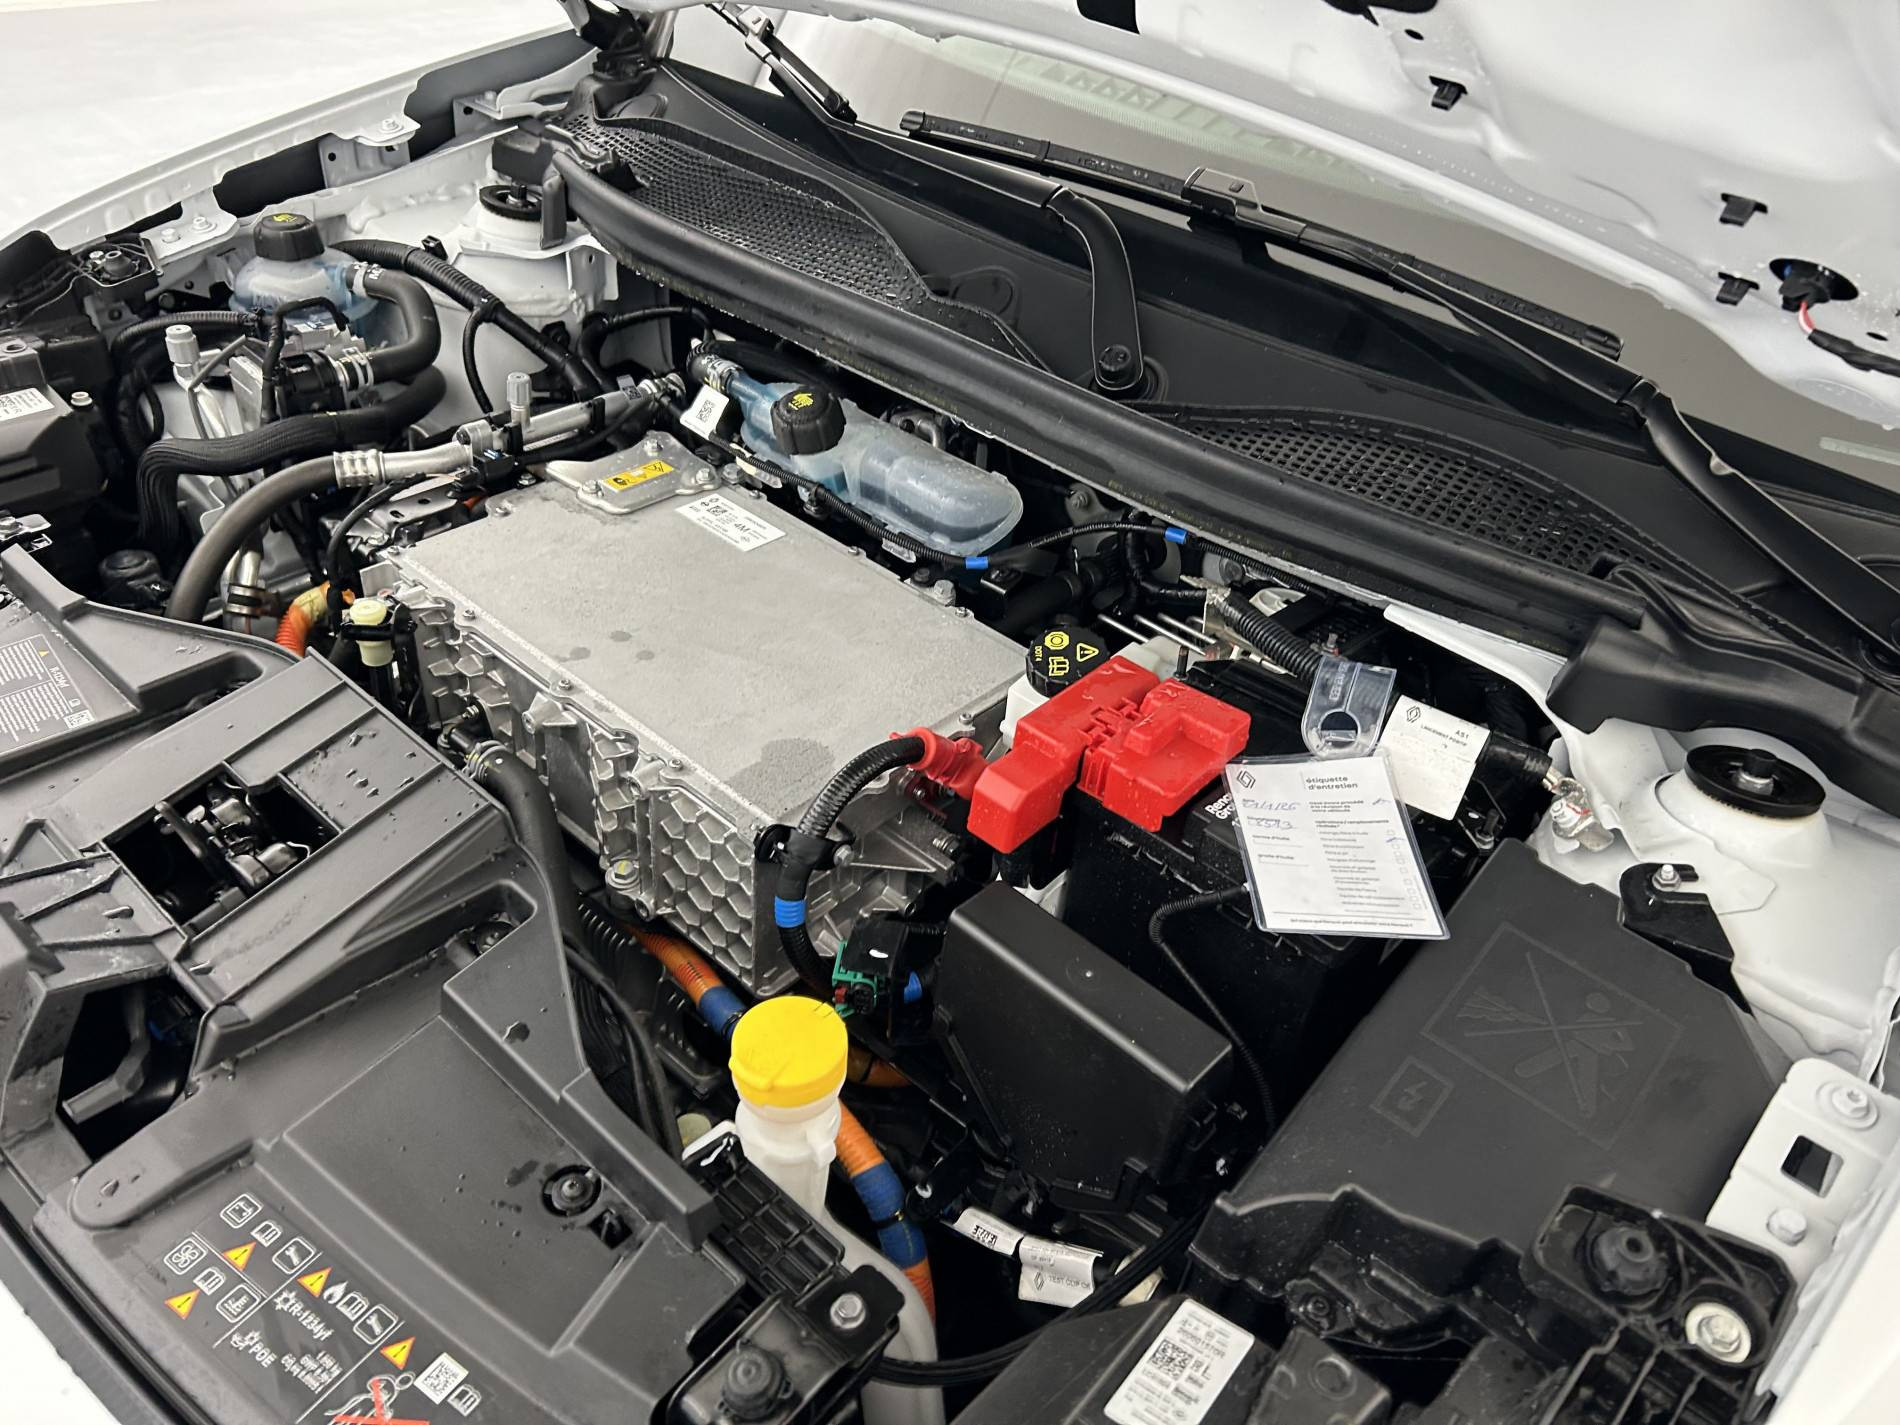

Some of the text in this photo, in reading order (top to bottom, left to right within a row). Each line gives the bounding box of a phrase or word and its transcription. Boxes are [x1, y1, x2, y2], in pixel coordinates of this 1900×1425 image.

[1305, 776, 1348, 784] étiquette
[288, 1301, 334, 1341] R-1234yf
[248, 1342, 277, 1368] POE
